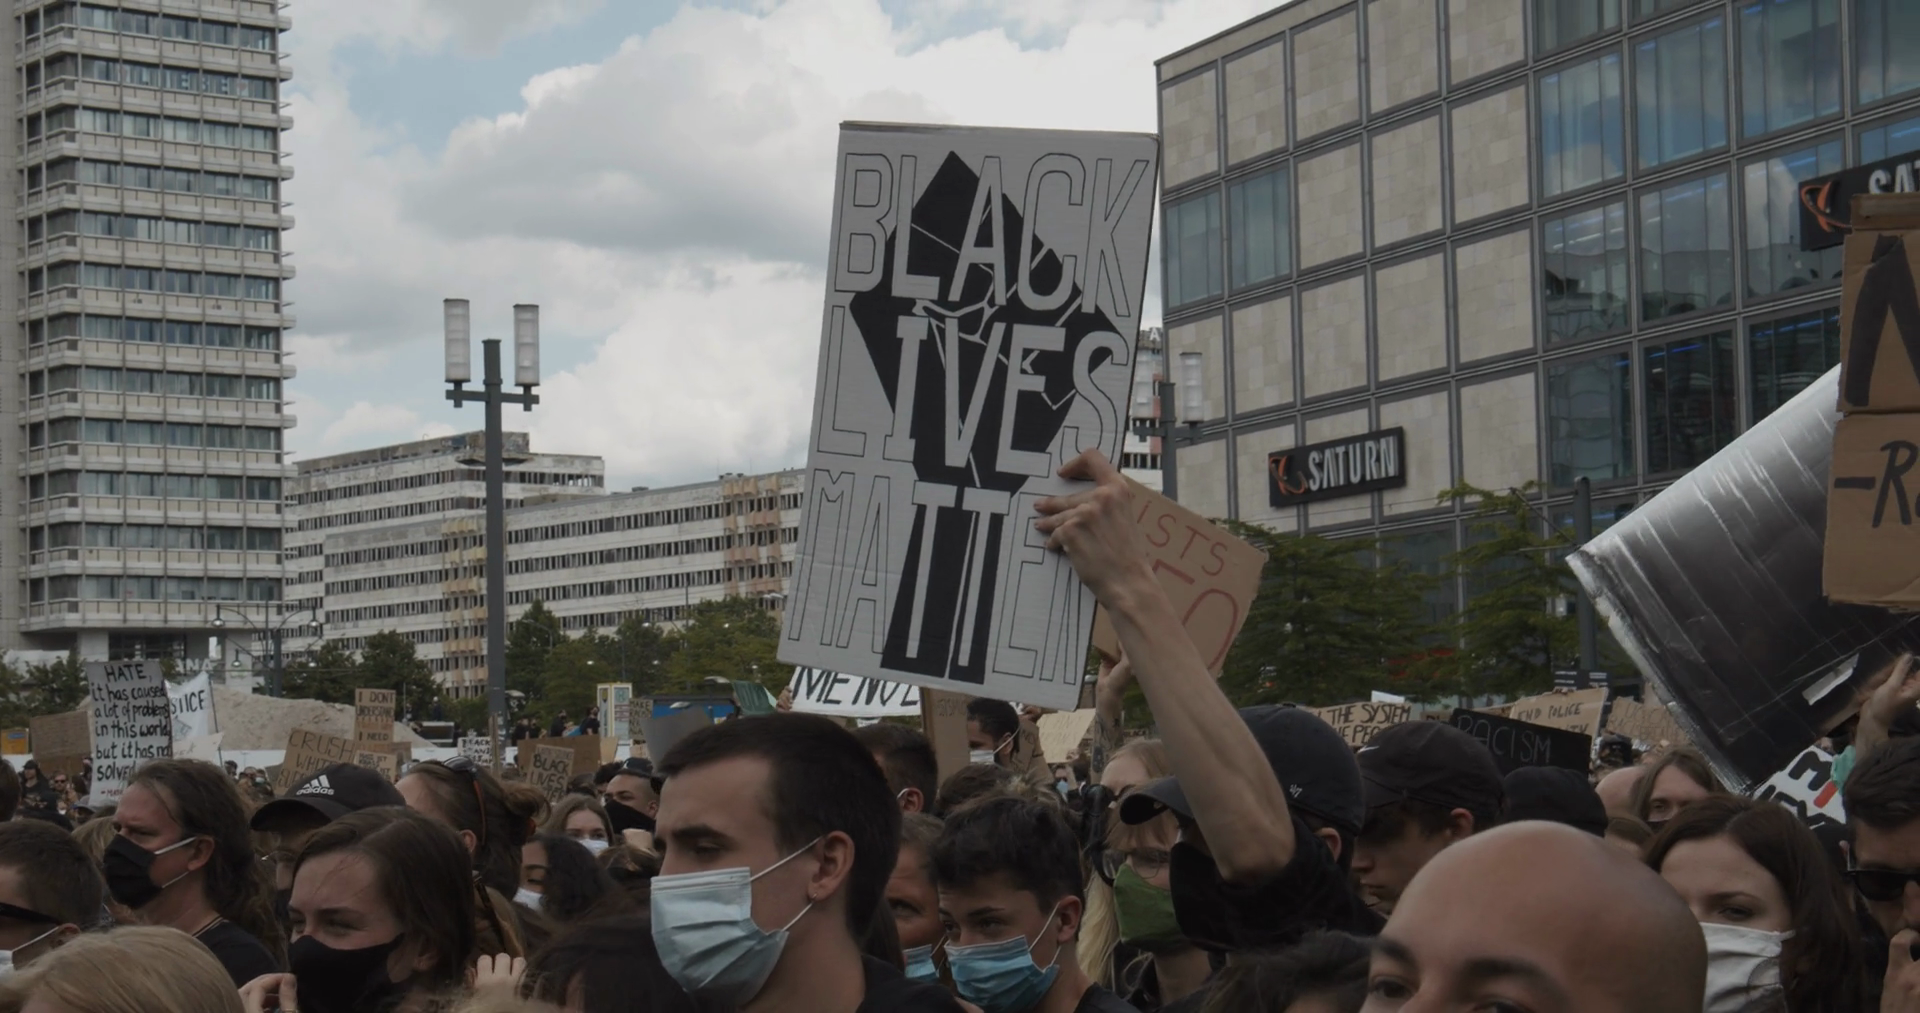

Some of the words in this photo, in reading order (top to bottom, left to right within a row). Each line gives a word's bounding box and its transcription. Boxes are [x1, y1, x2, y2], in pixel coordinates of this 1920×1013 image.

[834, 152, 1150, 318] BLACK
[817, 303, 1131, 479] LIVES
[1308, 435, 1399, 491] SATURN
[1133, 497, 1228, 577] ISTS
[104, 663, 153, 683] HATE,
[91, 682, 105, 702] it
[105, 683, 129, 702] has
[94, 707, 102, 718] a
[103, 701, 119, 719] lot
[121, 700, 131, 723] of
[1327, 704, 1357, 726] THE
[1361, 703, 1412, 725] SYSTEM
[1548, 702, 1585, 720] POLICE
[95, 720, 109, 737] in
[111, 718, 137, 738] this
[96, 741, 118, 760] but
[121, 741, 133, 759] it
[135, 741, 155, 759] has
[289, 730, 355, 761] CRUSH
[1457, 715, 1552, 765] RACISM
[533, 753, 570, 776] BLACK
[296, 786, 335, 796] adidas
[530, 770, 566, 790] LIVES
